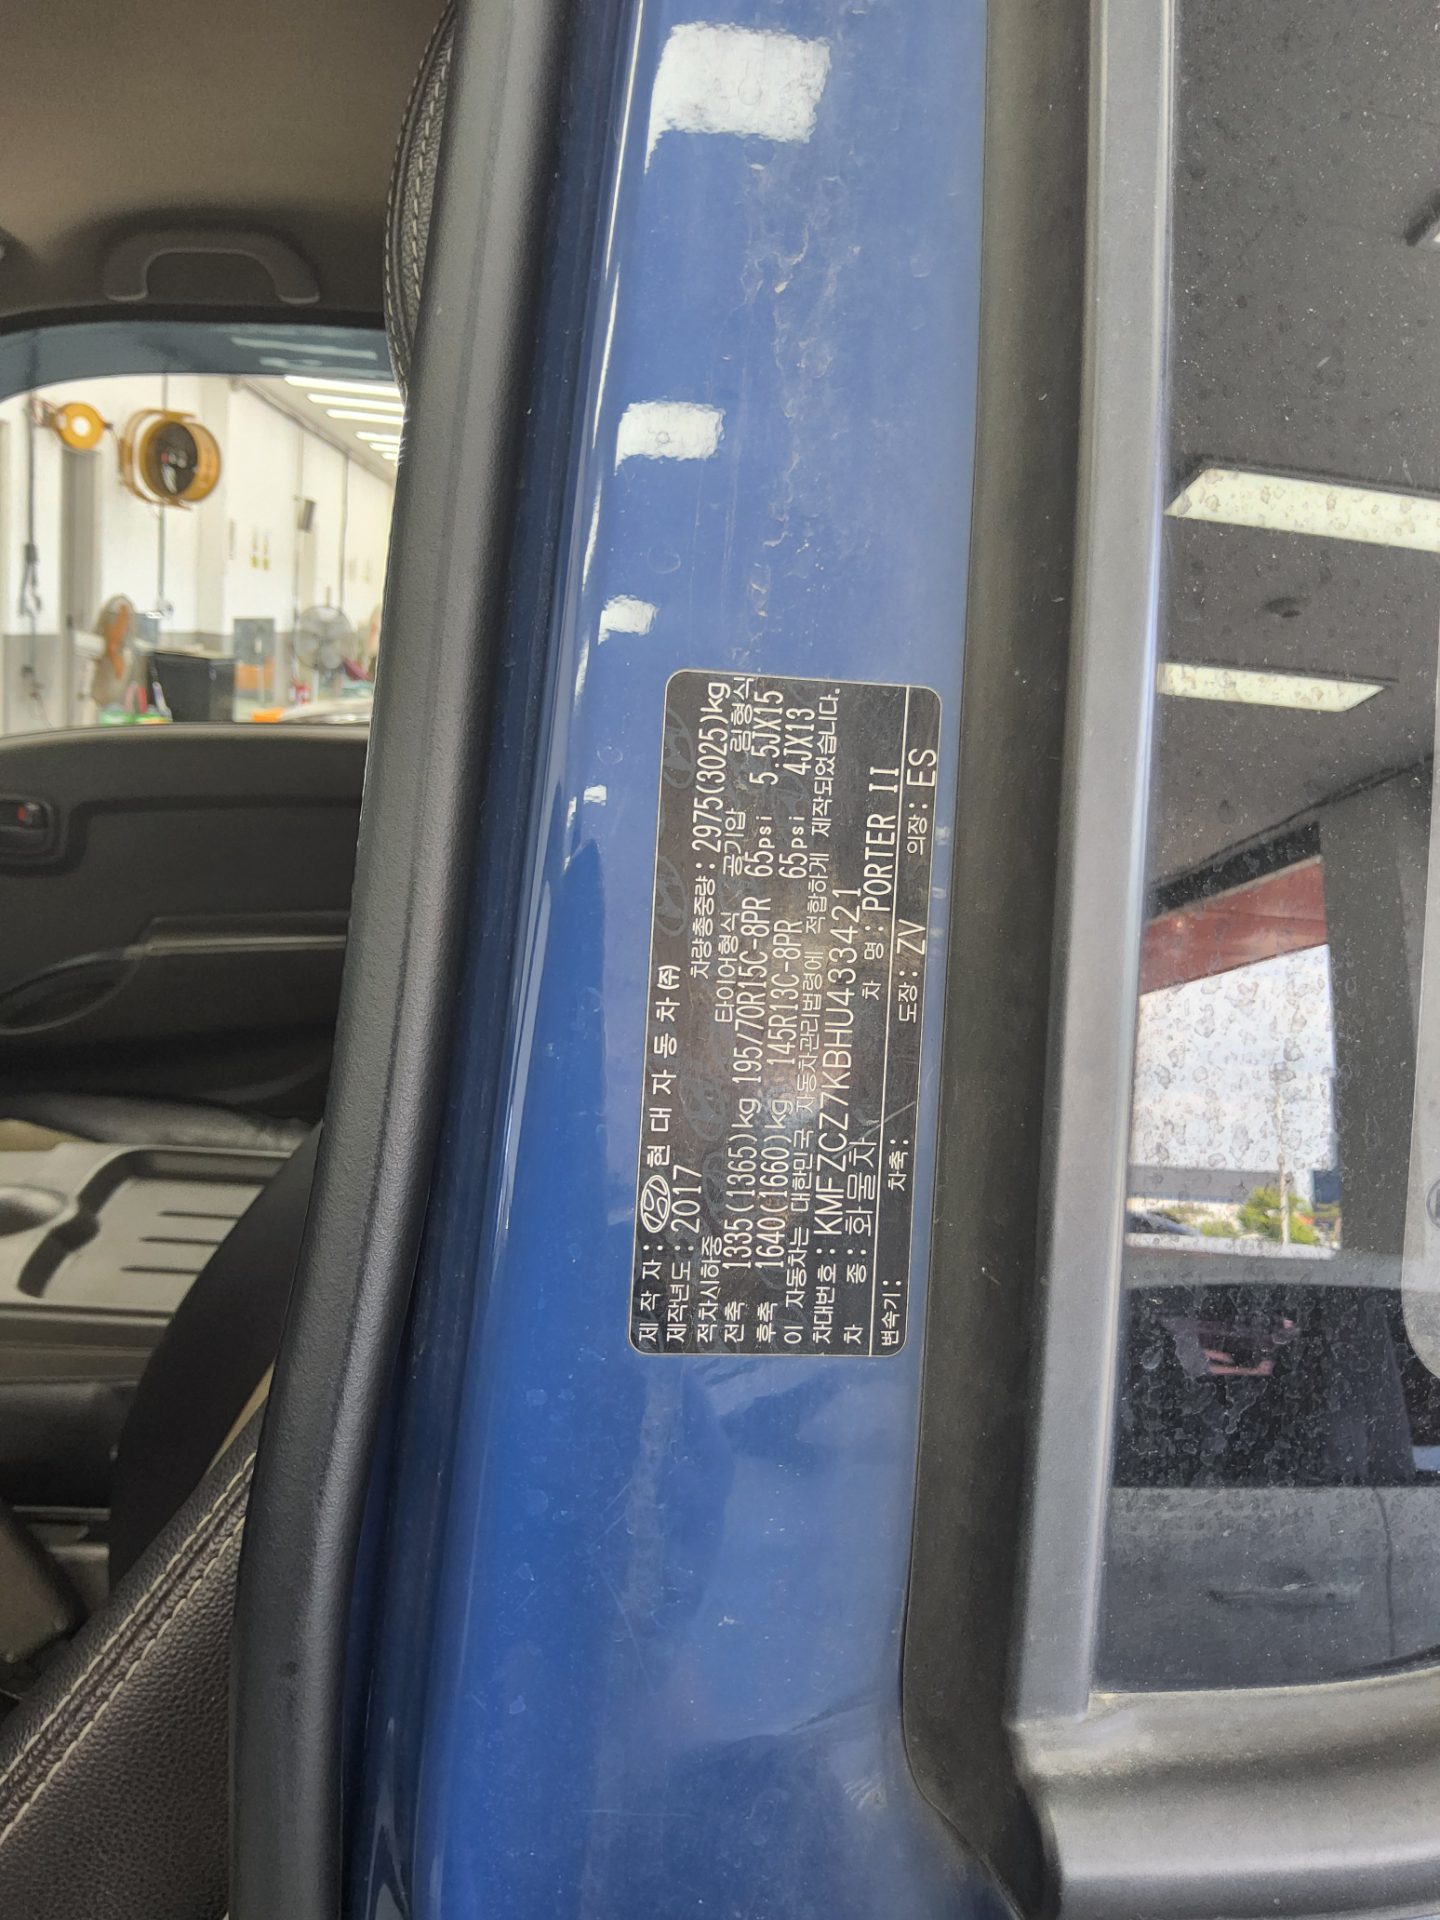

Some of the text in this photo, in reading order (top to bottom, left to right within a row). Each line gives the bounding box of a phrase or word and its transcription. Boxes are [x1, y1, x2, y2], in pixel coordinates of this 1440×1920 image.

[691, 682, 730, 852] 2975(3025)kg
[869, 767, 898, 793] II
[907, 748, 936, 786] ES
[714, 677, 754, 1022] 타이어형식 공기압 림형식
[862, 814, 896, 911] PORTER
[896, 919, 926, 954] ZV
[722, 690, 783, 1343] 전축 1335(1365)kg 195/70R15C-8PR 65psi 5.5JX15
[756, 708, 815, 1343] 후축 1640(1660)kg 145R13C-8PR 65psi 4JX13
[784, 688, 840, 1344] 이 자동차는 대한민국 자동차관리법령에 적합하게 제작되었습니다.
[814, 888, 861, 1235] KMFZCZ7KBHU433421
[845, 1138, 877, 1236] 화물차
[888, 1140, 909, 1191] 차축:
[666, 1164, 702, 1343] 제작년도: 2017
[697, 1236, 722, 1343] 적차시하중
[881, 1280, 901, 1346] 변속기:
